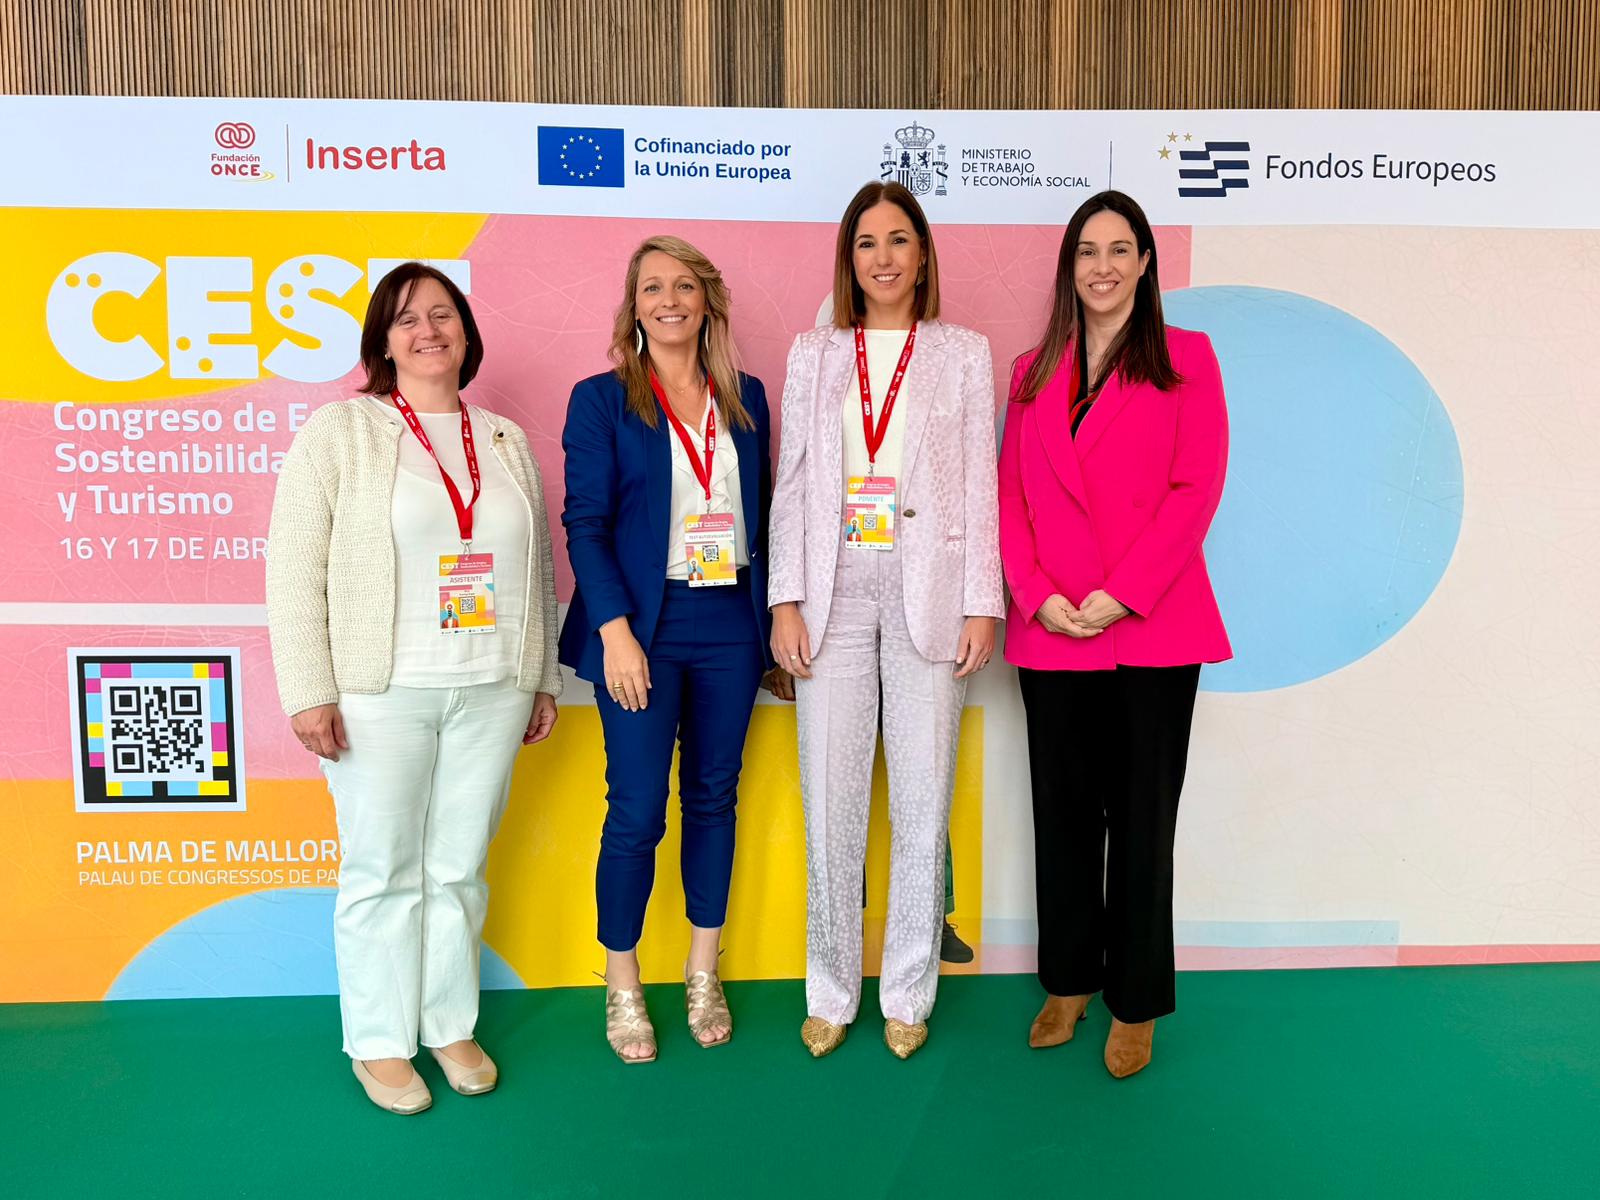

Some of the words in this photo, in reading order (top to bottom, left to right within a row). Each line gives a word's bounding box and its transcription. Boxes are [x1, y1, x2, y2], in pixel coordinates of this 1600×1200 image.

[210, 151, 261, 163] Fundación
[306, 137, 447, 171] Inserta
[634, 137, 755, 157] Cofinanciado
[761, 142, 792, 160] por
[961, 148, 1032, 160] MINISTERIO
[210, 163, 261, 177] ONCE
[634, 159, 651, 176] la
[656, 160, 710, 178] Unión
[715, 163, 792, 183] Europea
[961, 162, 978, 173] DE
[979, 162, 1035, 174] TRABAJO
[1266, 152, 1364, 180] Fondos
[1372, 154, 1496, 187] Europeos
[961, 175, 970, 186] Y
[973, 173, 1043, 187] ECONOMÍA
[1046, 176, 1091, 188] SOCIAL
[54, 401, 222, 439] Congreso
[234, 402, 276, 432] de
[57, 492, 77, 521] y
[86, 484, 233, 515] Turismo
[60, 537, 93, 559] 16
[100, 537, 117, 559] Y
[127, 537, 159, 559] 17
[168, 537, 205, 559] DE
[76, 841, 174, 863] PALMA
[181, 840, 217, 863] DE
[79, 871, 135, 886] PALAU
[140, 870, 163, 885] DE
[168, 869, 285, 885] CONGRESSOS
[289, 869, 312, 884] DE
